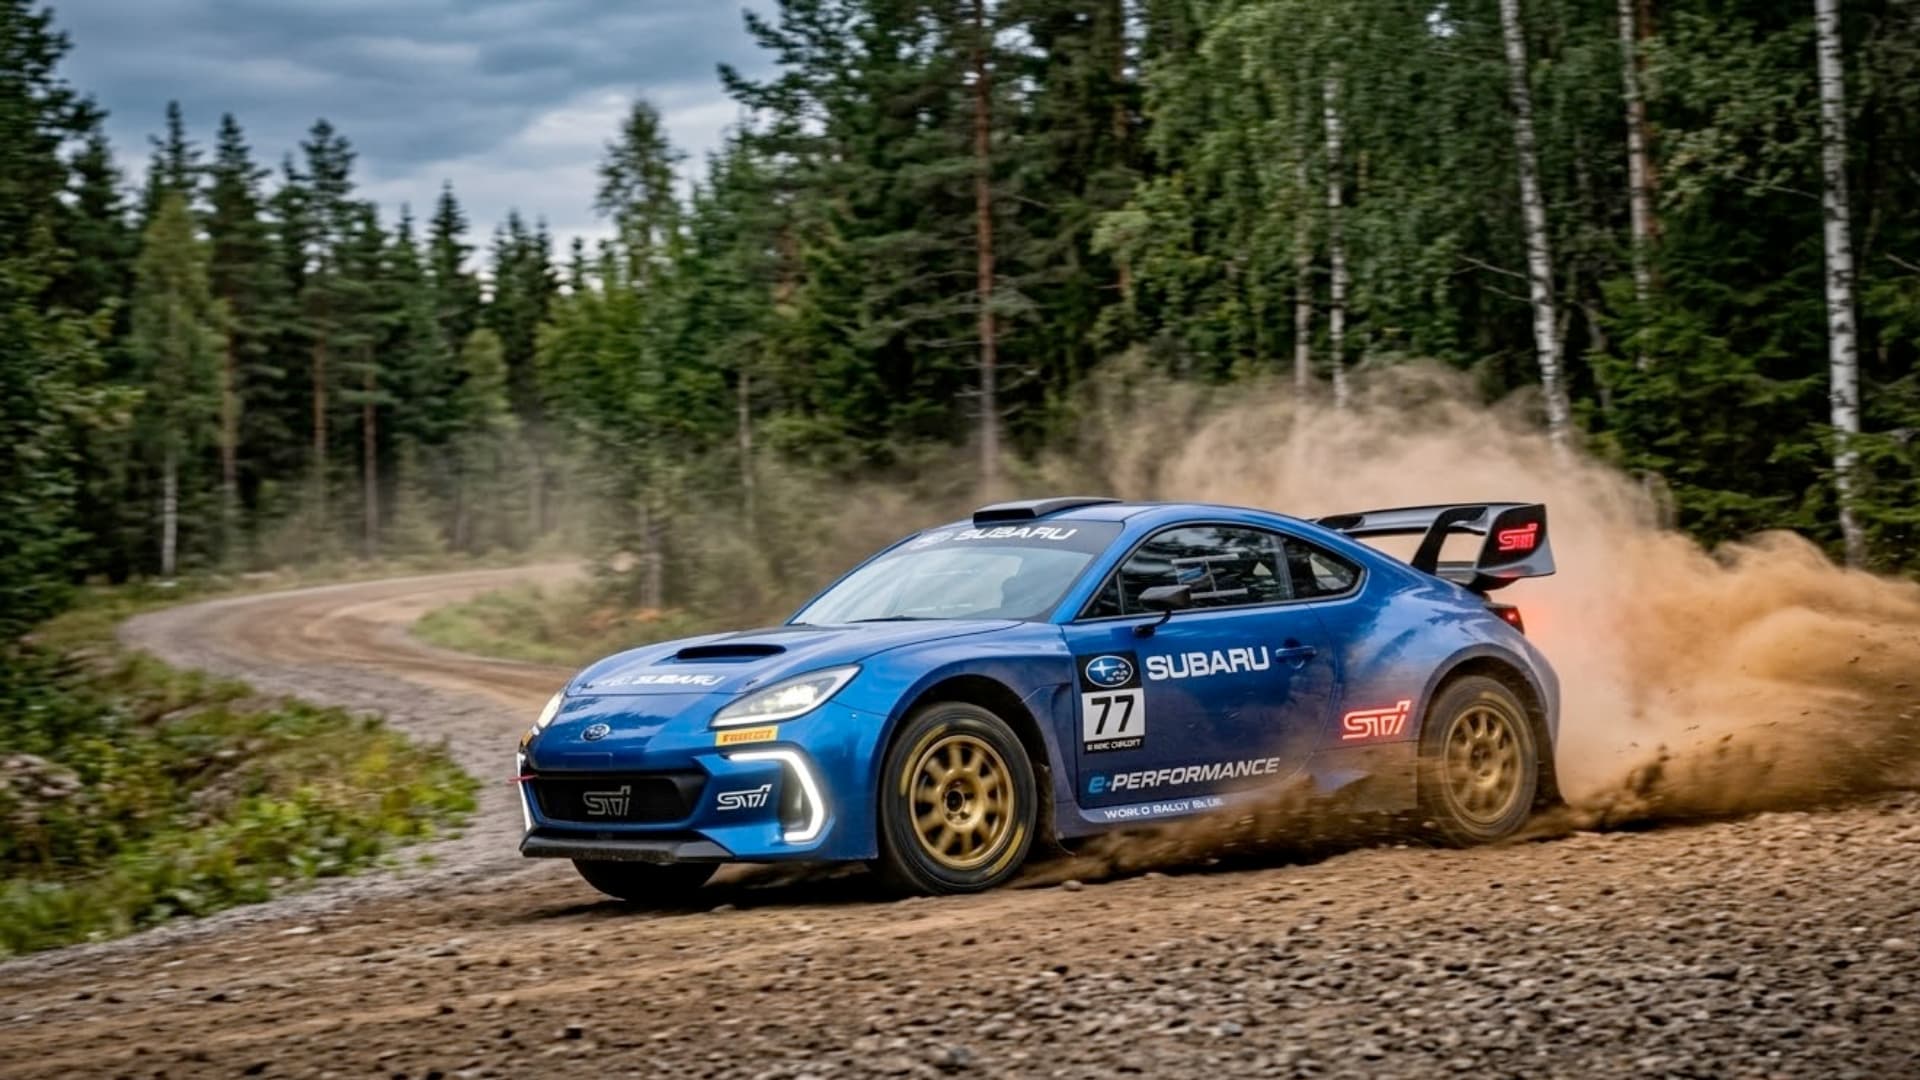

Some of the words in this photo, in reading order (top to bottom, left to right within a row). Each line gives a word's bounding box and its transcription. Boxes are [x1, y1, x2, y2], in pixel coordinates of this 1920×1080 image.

[953, 526, 1078, 541] SUBARU
[1145, 646, 1271, 681] SUBARU
[1091, 694, 1134, 736] 77
[1104, 806, 1150, 819] WORLD
